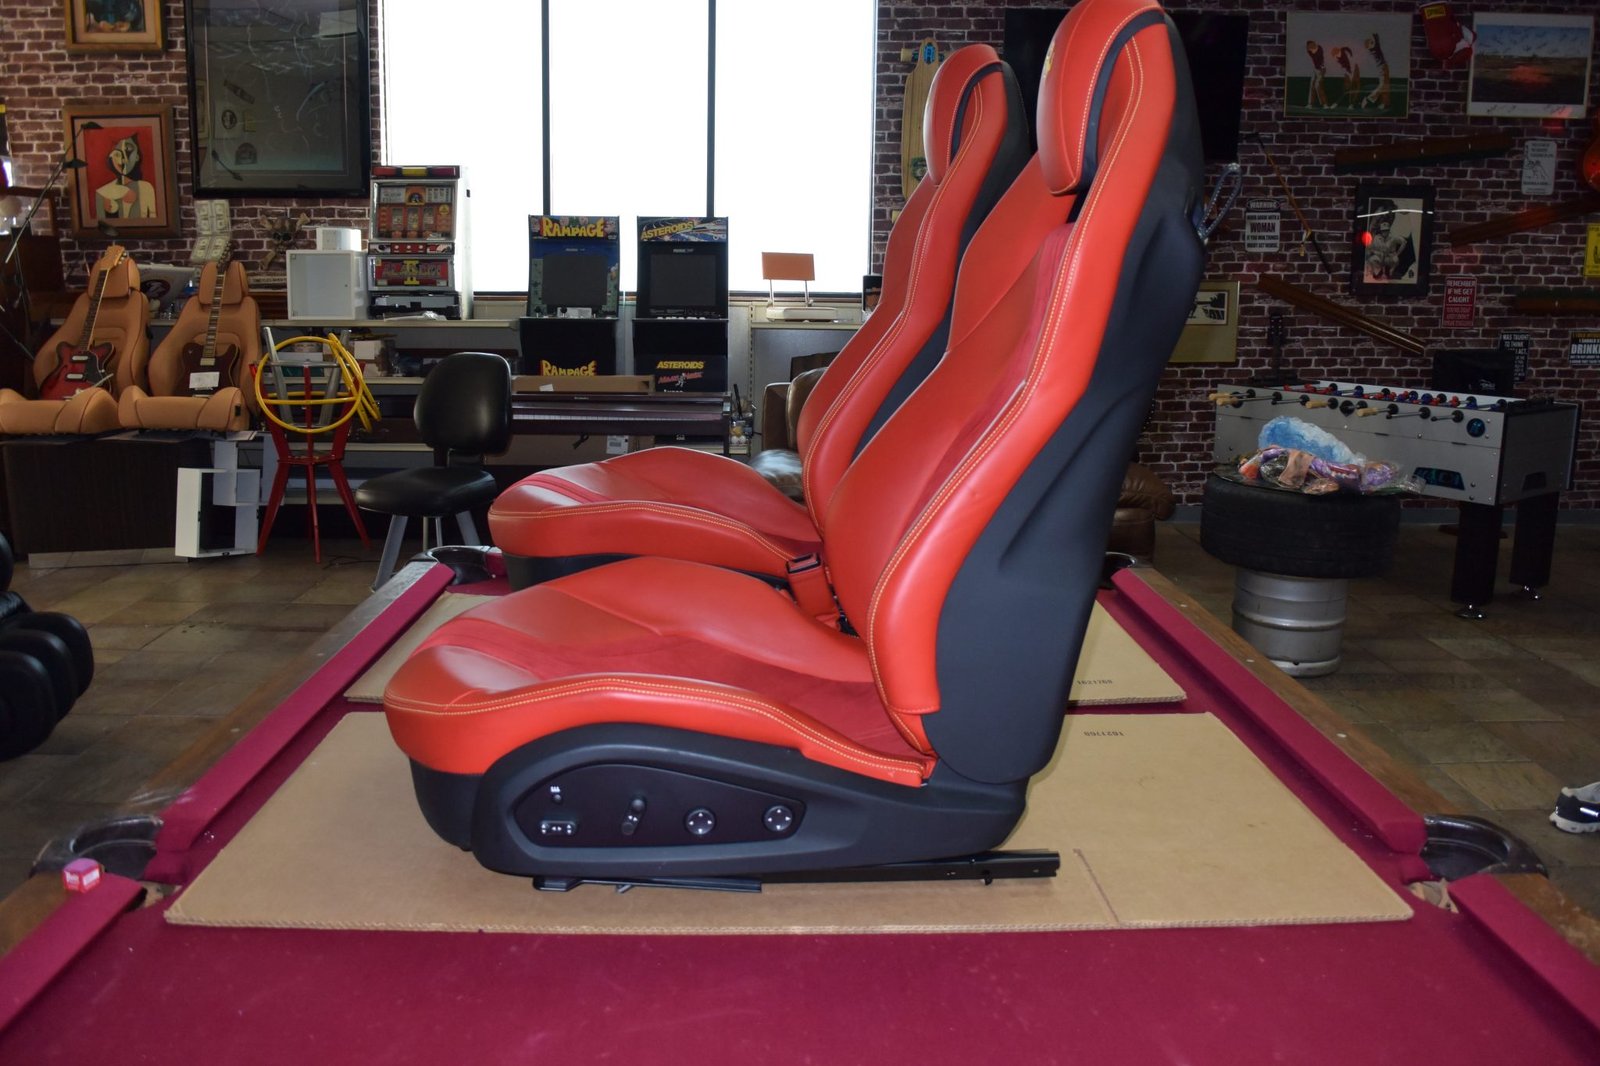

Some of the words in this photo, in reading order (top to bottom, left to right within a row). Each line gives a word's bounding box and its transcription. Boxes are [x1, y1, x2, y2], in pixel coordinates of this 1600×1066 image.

[541, 216, 604, 237] RAMPAGE
[640, 220, 694, 241] ASTEROIDS
[1250, 222, 1276, 232] WOMAN
[541, 360, 597, 376] RAMPAGE
[656, 360, 704, 370] ASTEROIDS
